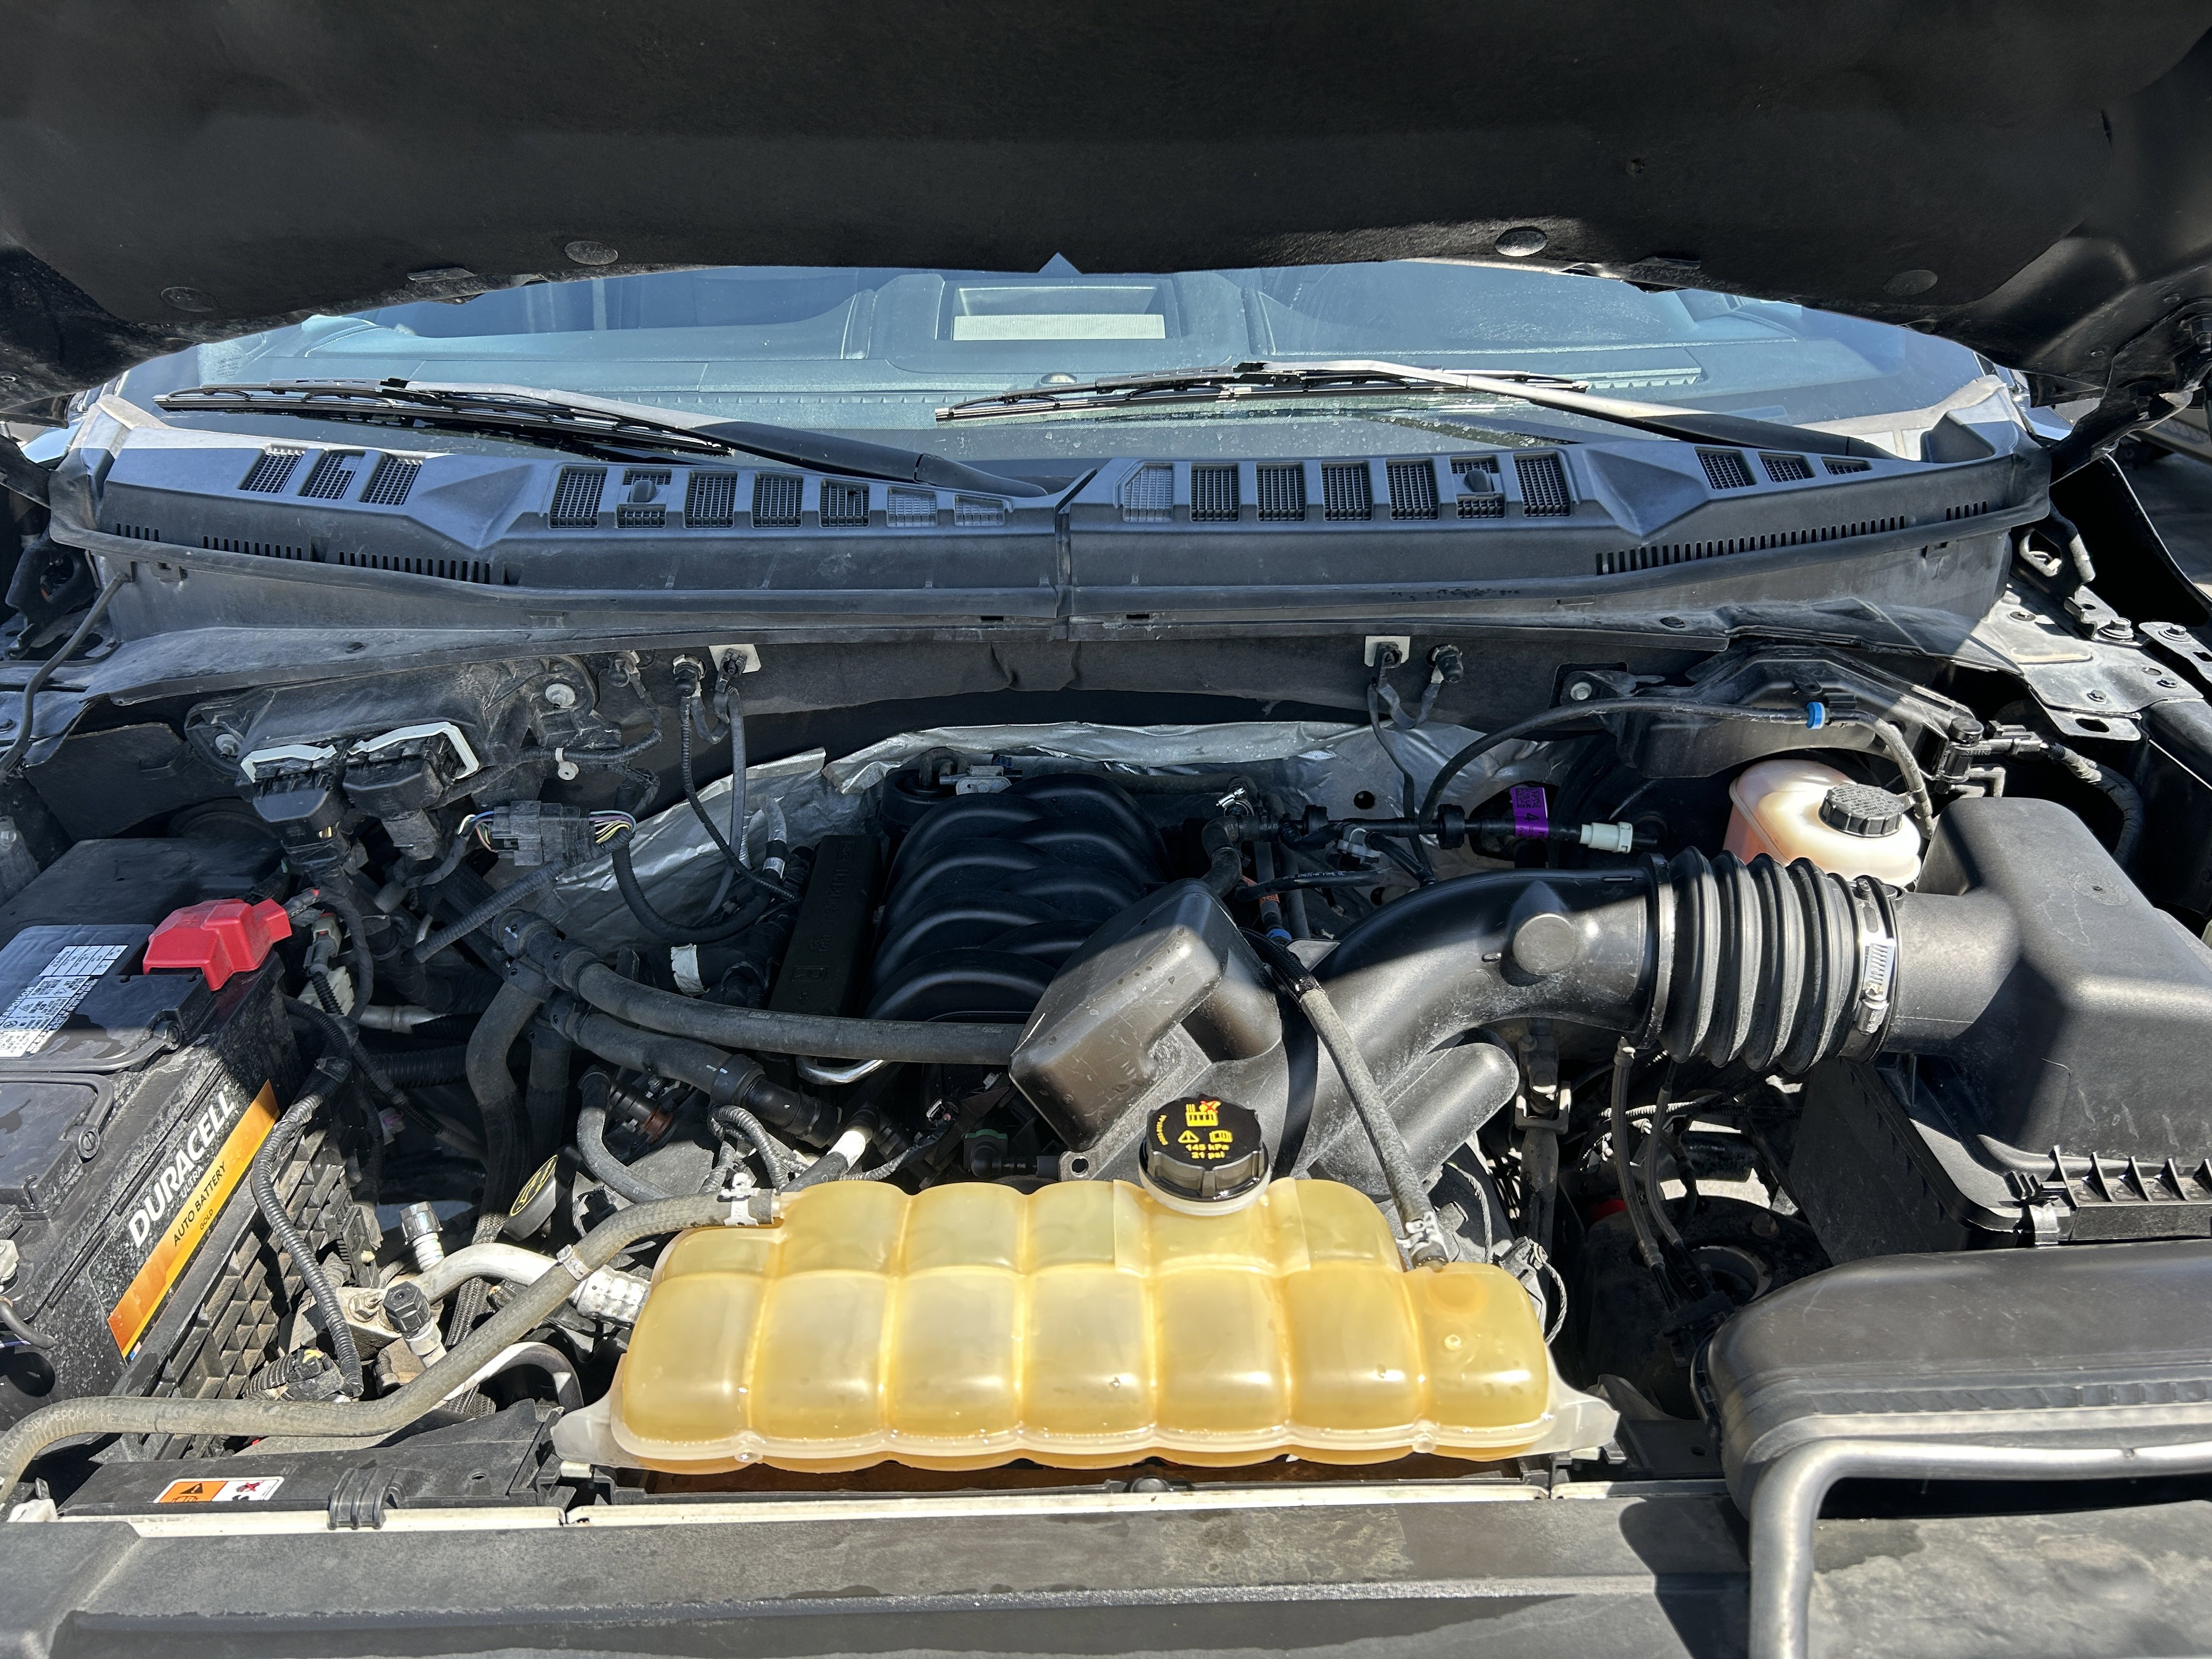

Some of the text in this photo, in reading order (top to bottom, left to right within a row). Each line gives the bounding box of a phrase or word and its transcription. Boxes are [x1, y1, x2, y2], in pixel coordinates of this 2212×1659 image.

[128, 1091, 235, 1248] DURACELL
[1207, 1151, 1226, 1160] psi
[179, 1165, 204, 1199] ULTRA
[173, 1160, 226, 1247] AUTO BATTERY
[200, 1209, 214, 1231] GOLD
